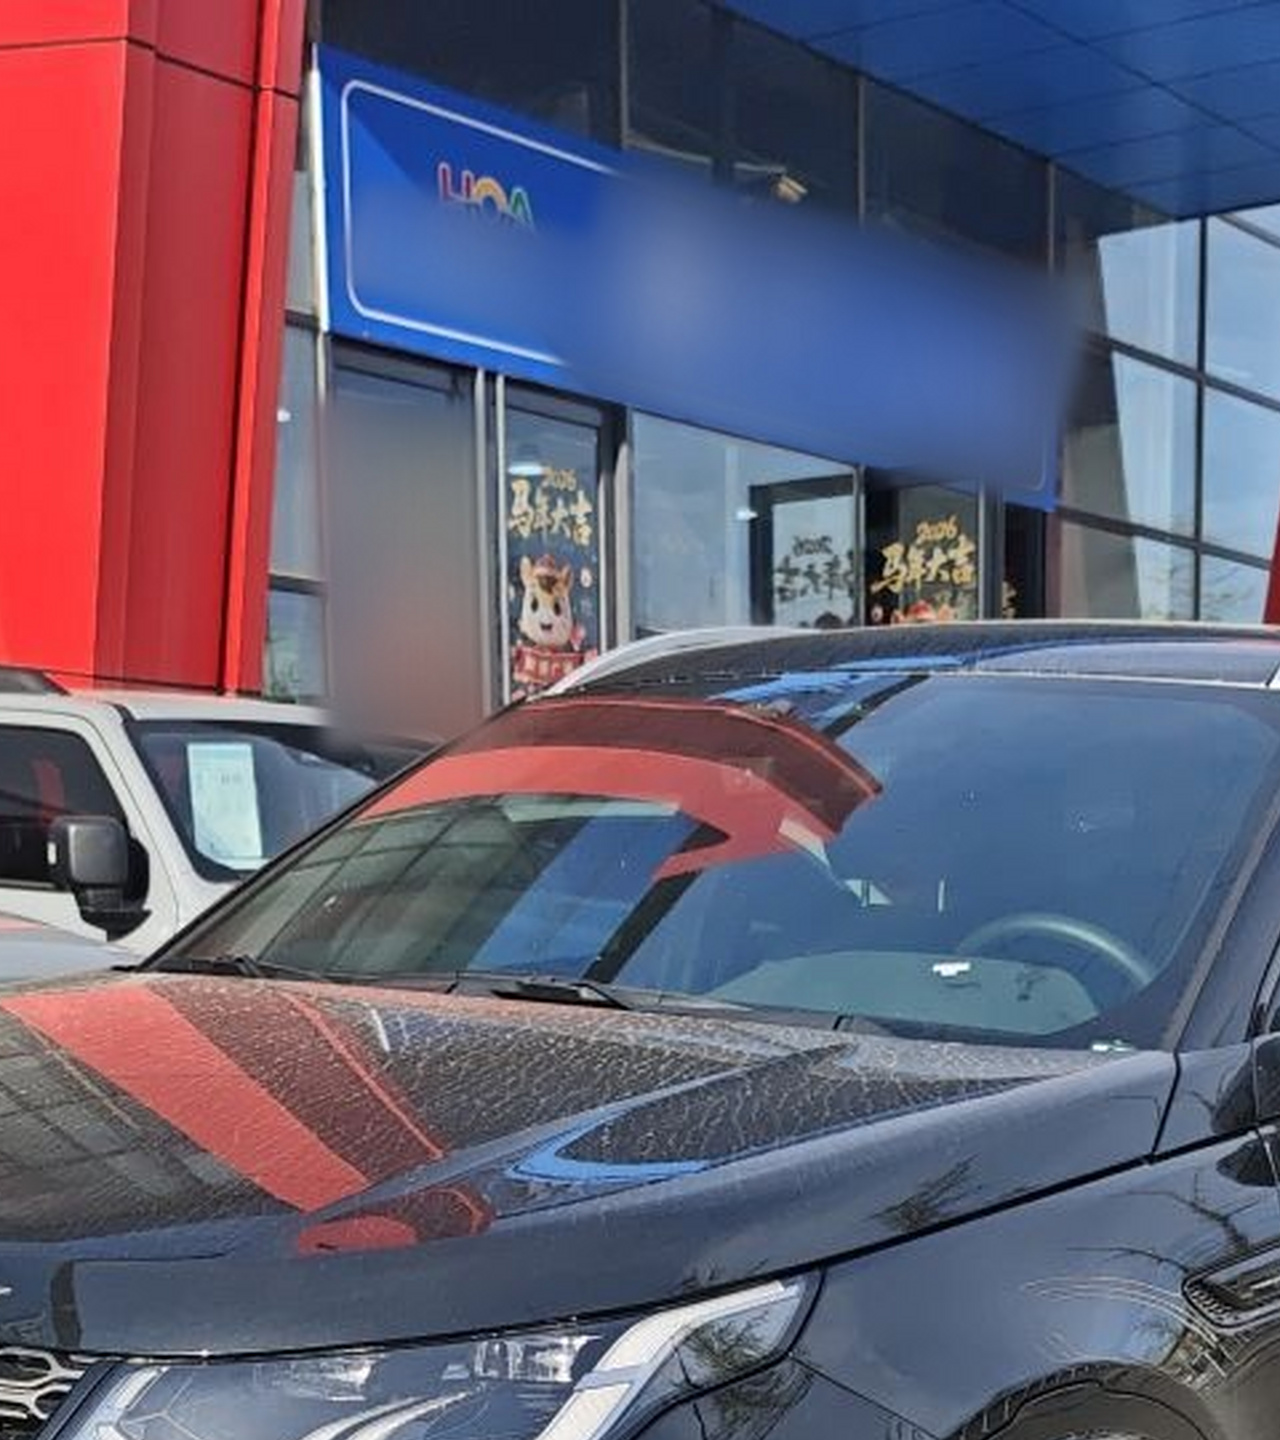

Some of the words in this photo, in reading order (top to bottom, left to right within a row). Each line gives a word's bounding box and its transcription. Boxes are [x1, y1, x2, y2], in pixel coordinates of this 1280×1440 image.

[508, 479, 592, 546] 马年大吉
[915, 514, 958, 544] 2026
[871, 534, 976, 594] 马年大吉
